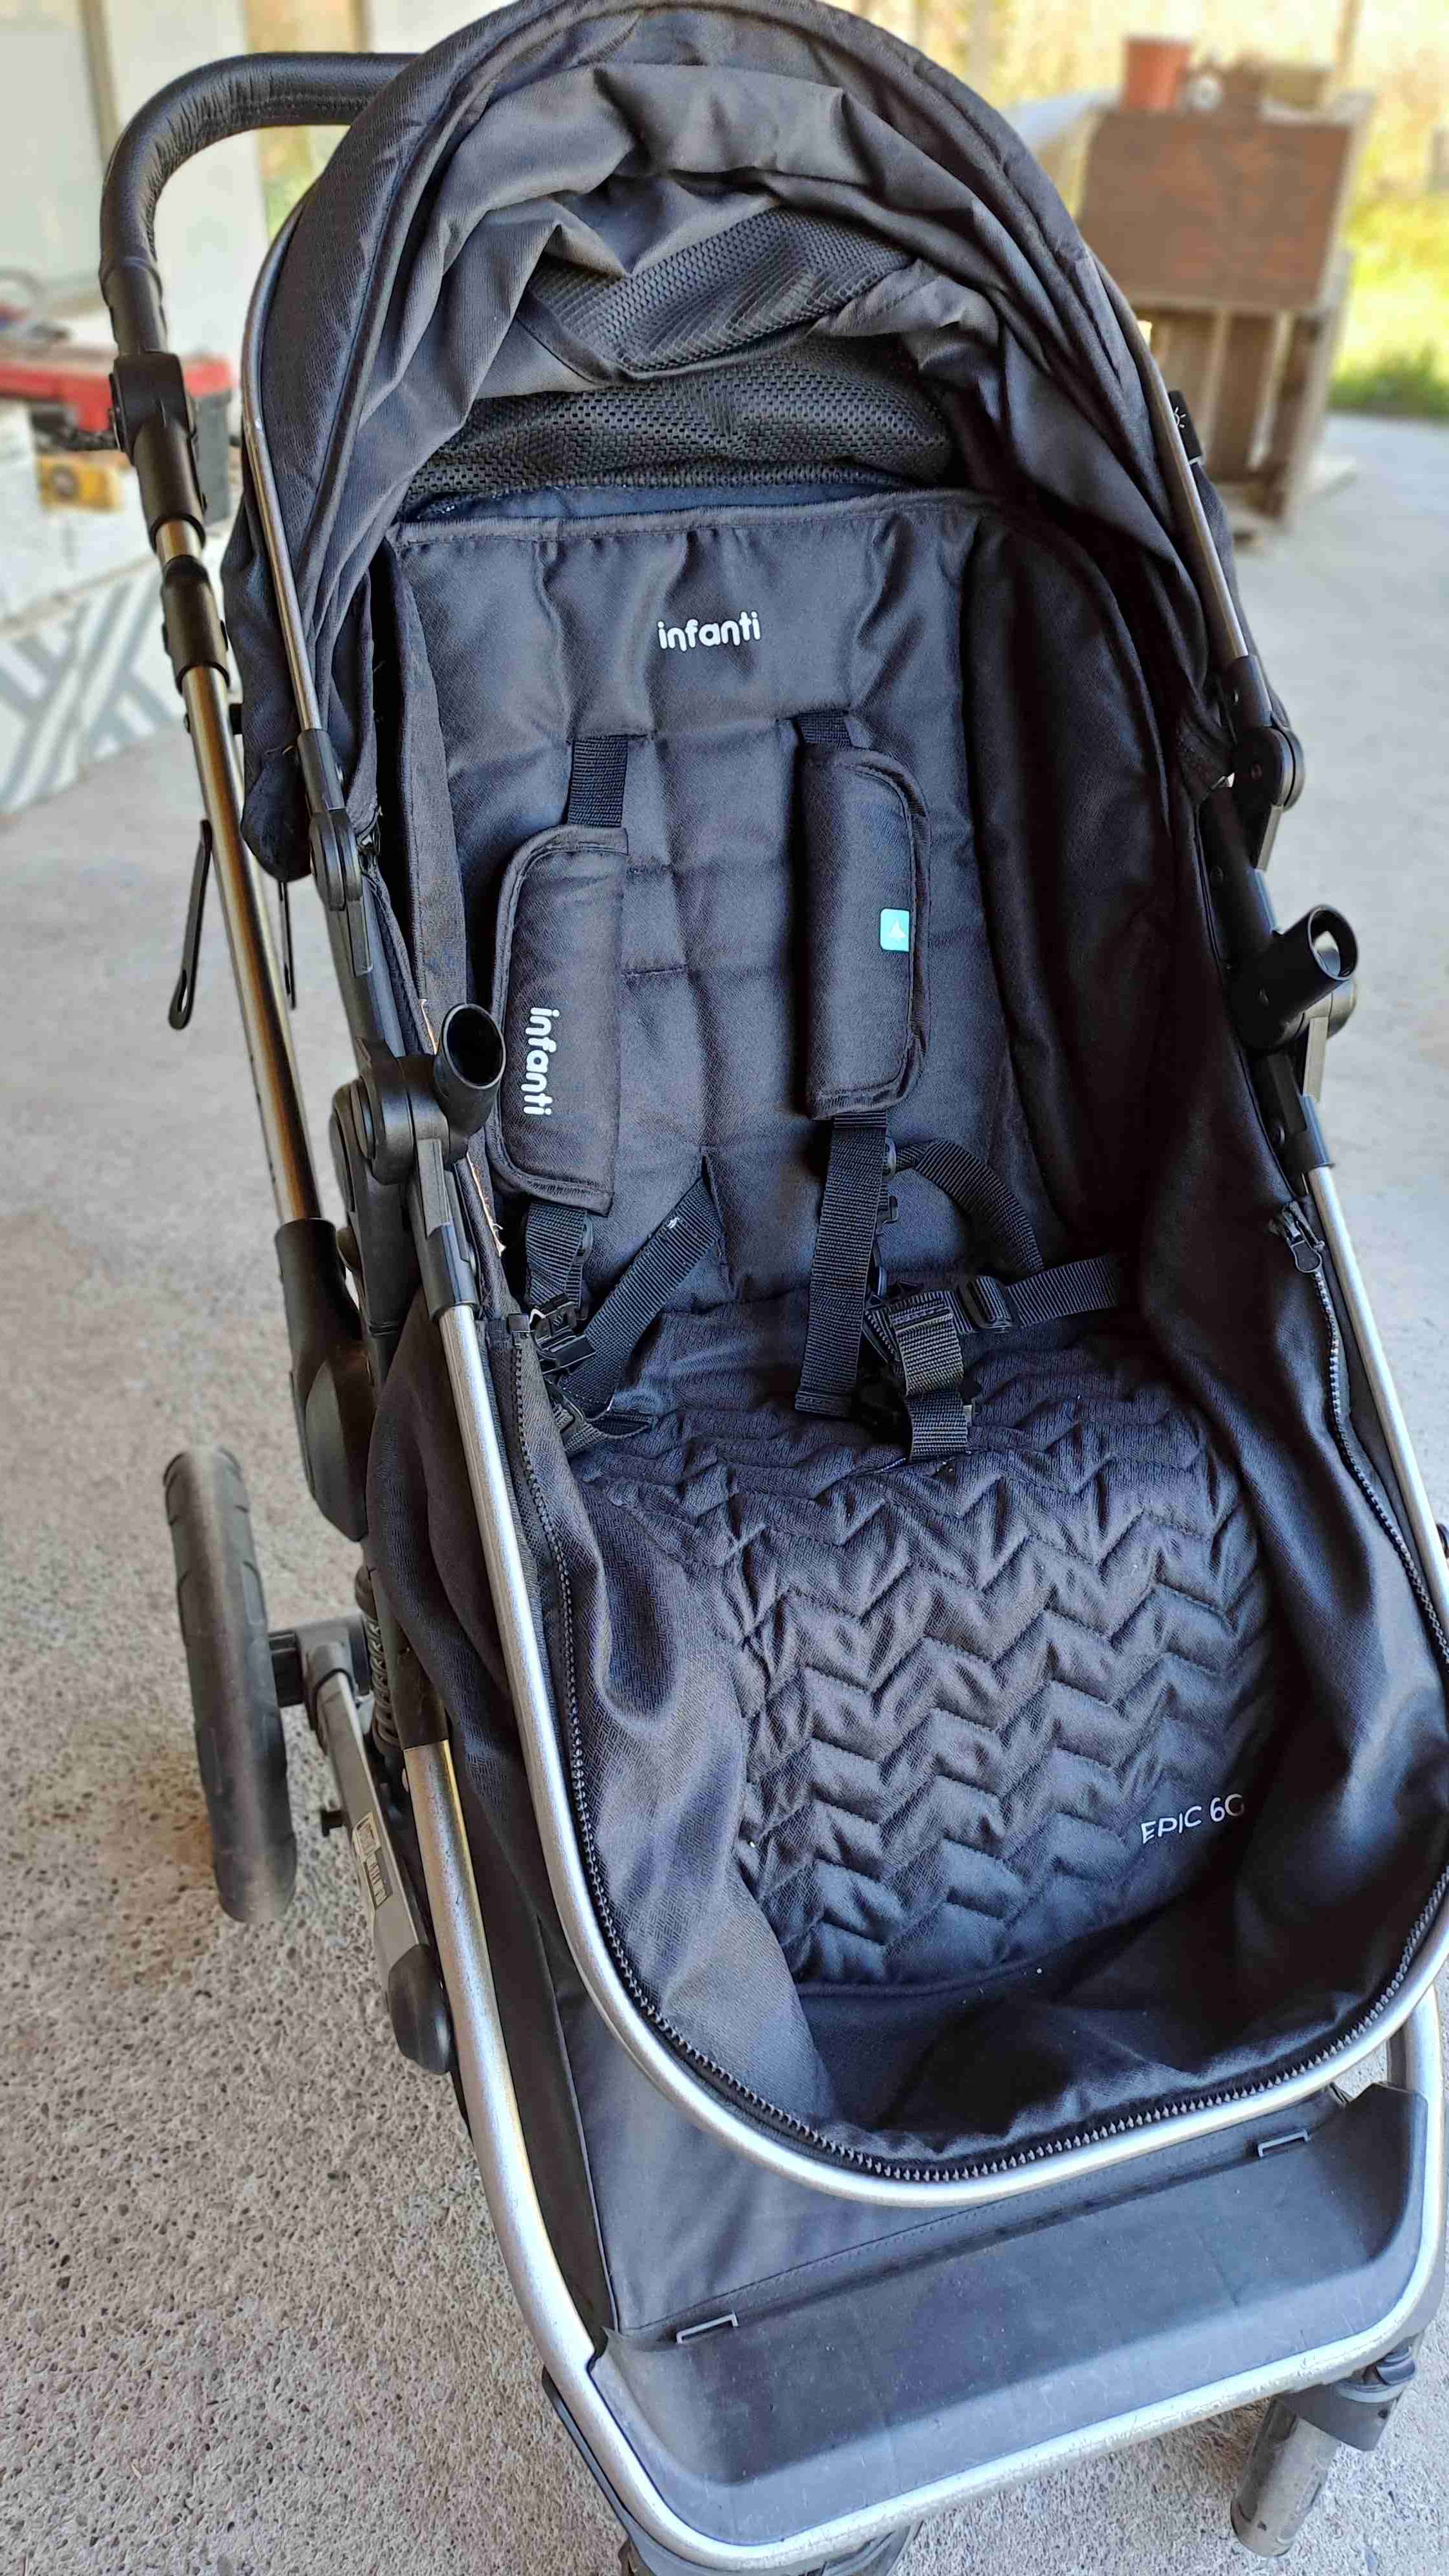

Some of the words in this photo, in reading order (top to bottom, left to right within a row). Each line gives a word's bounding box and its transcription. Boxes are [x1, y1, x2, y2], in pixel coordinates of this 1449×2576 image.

[657, 611, 761, 652] infanti
[520, 1007, 560, 1115] infanti
[1141, 1806, 1202, 1844] EPIC
